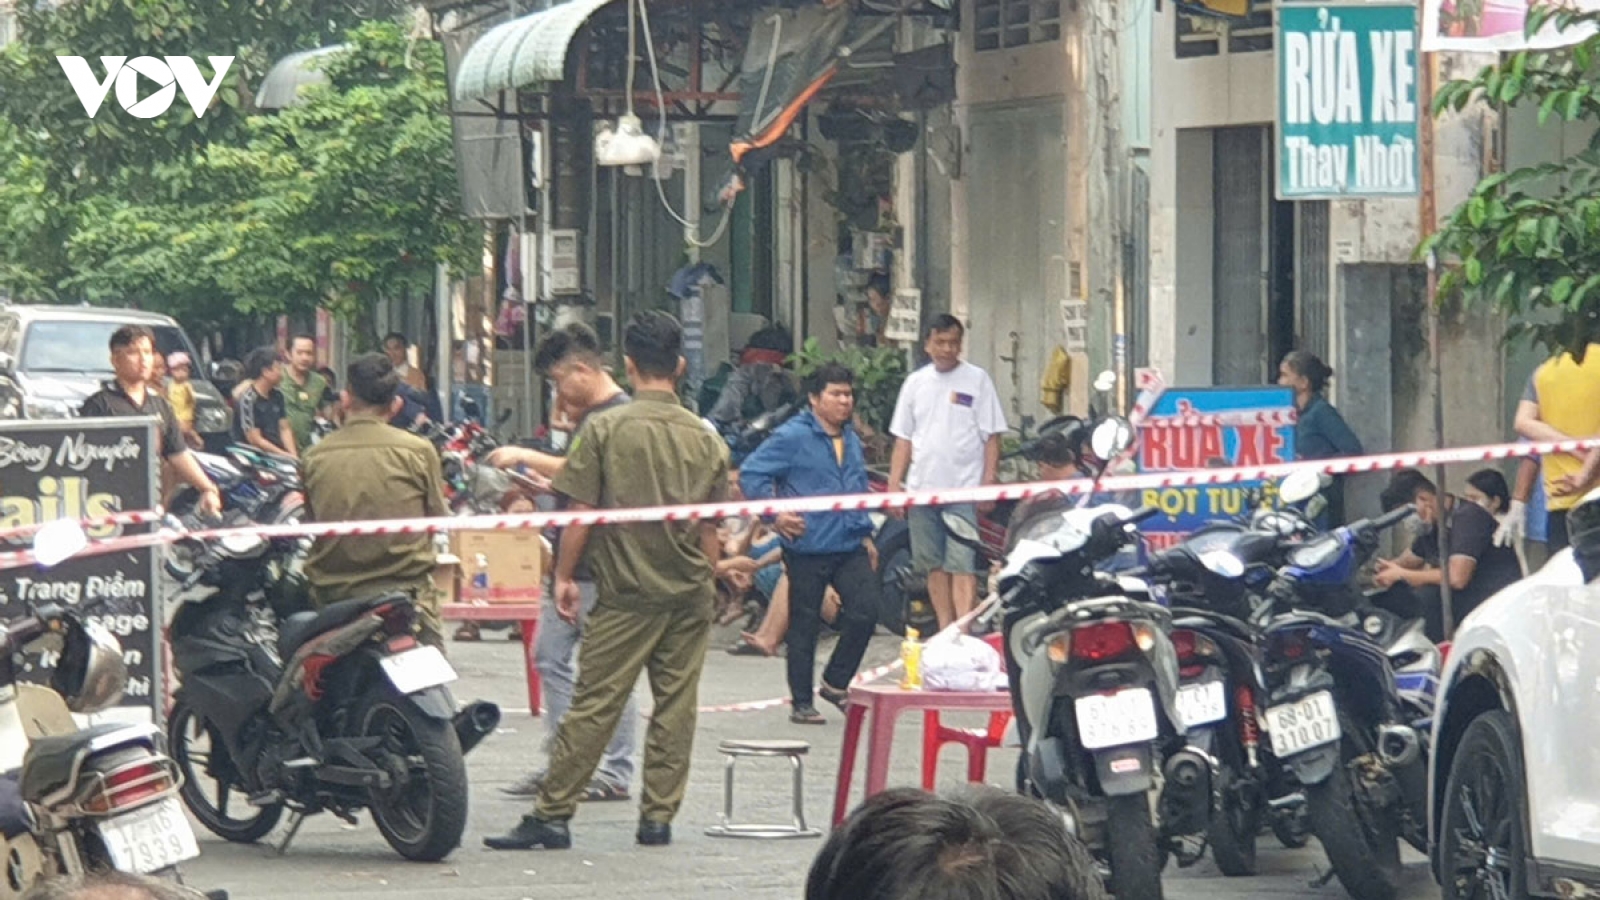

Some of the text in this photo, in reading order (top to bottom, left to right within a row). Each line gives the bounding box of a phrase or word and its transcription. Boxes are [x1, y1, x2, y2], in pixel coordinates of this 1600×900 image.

[1285, 8, 1415, 125] RỬA XE
[1284, 136, 1348, 193] Thay
[1236, 420, 1285, 468] XE
[15, 577, 81, 604] Trang
[86, 570, 146, 598] Điểm
